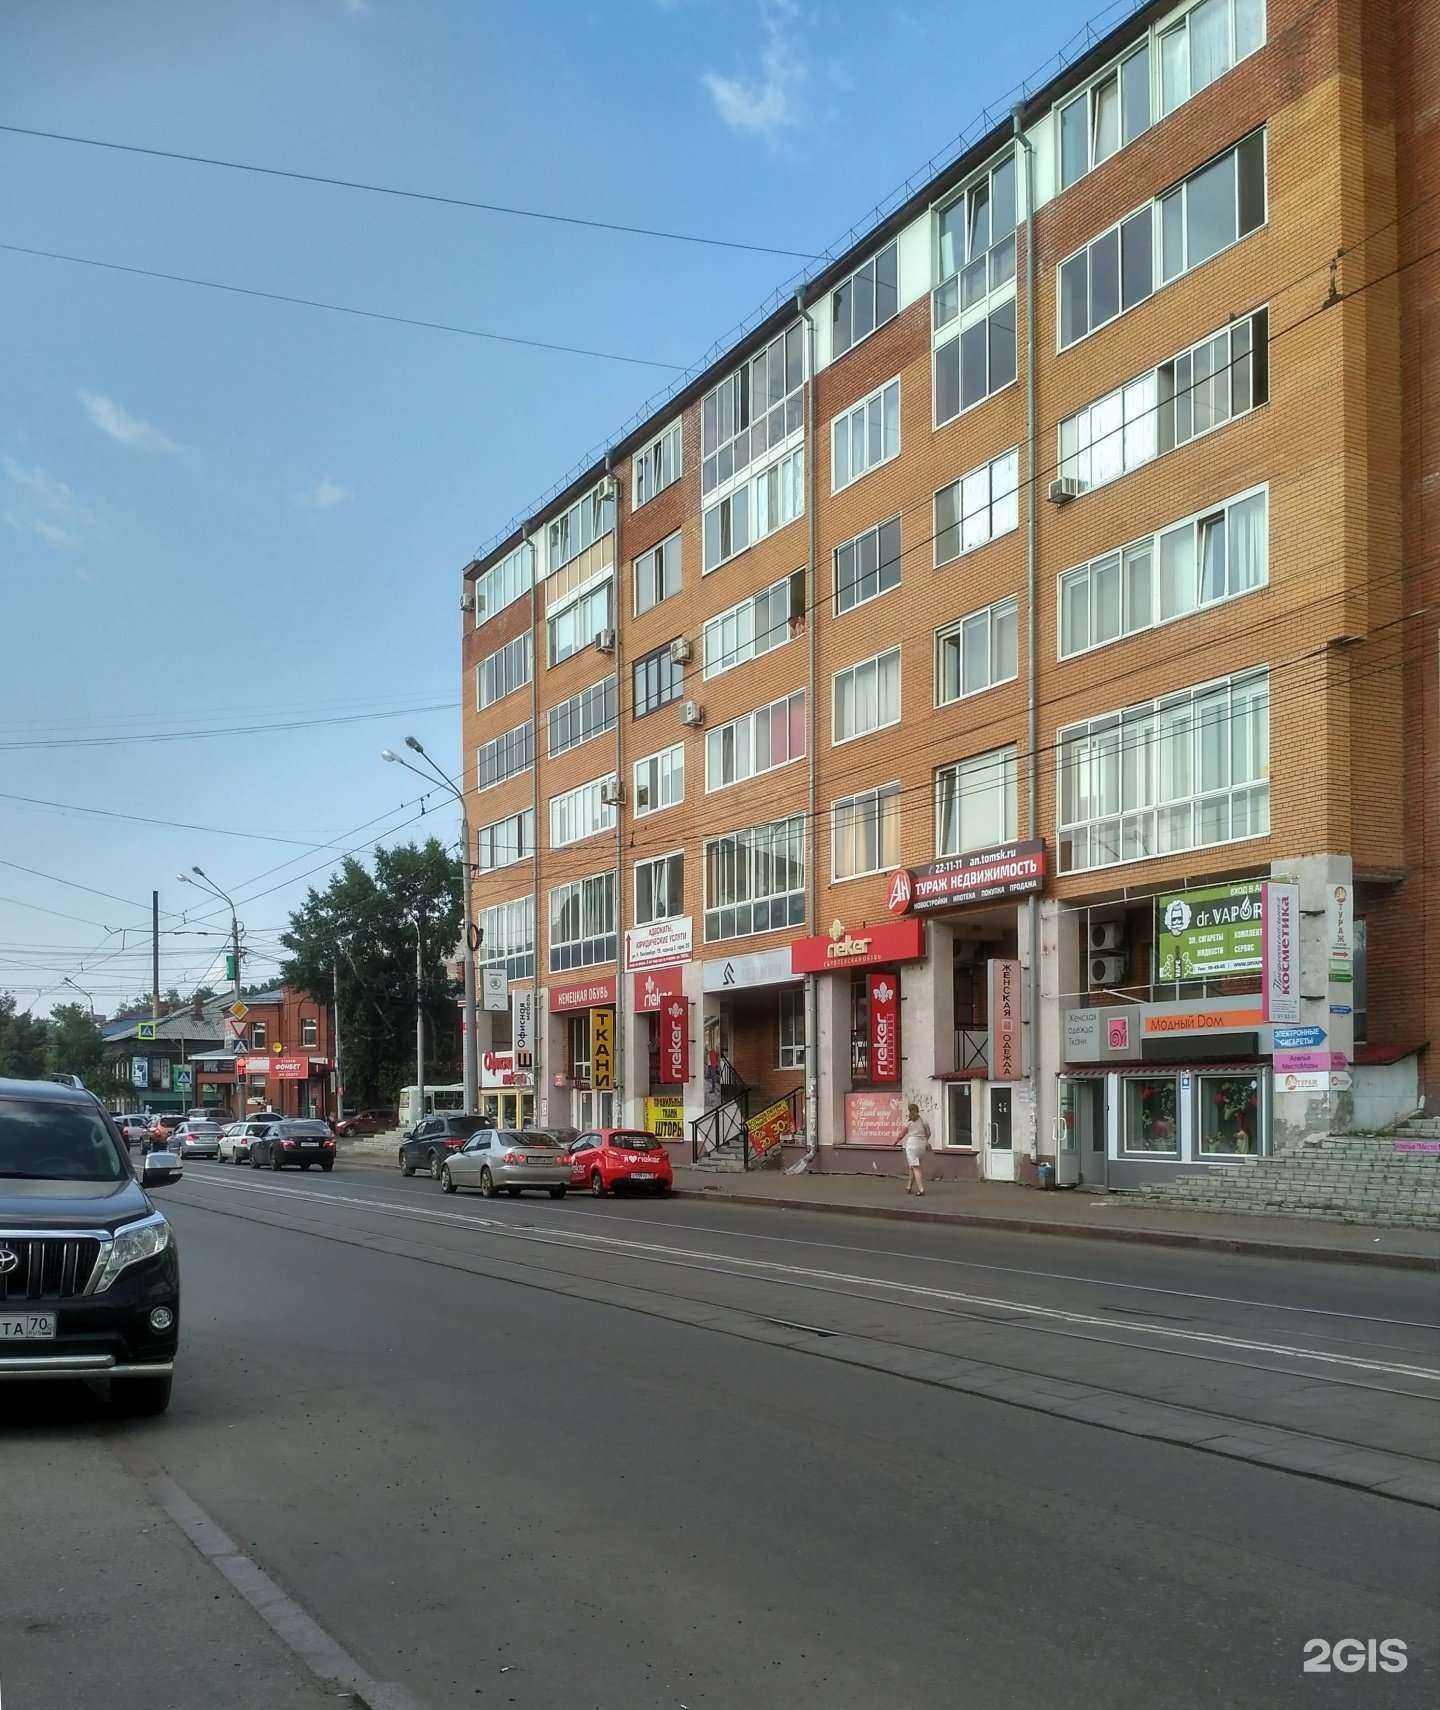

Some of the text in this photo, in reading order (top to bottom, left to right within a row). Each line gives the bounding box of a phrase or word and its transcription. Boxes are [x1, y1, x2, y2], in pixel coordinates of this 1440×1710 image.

[935, 849, 1017, 874] 22-11-11 an.tomsk.ru
[914, 859, 1037, 896] ТУРАЖ НЕДВИЖИМОСТЬ
[913, 879, 1037, 910] НОВОСТРОЙКИ ИПОТЕКА ПОКУПКА ПРОДАЖА
[1337, 903, 1345, 943] ТУРАЖ
[827, 935, 873, 958] rieker
[1198, 932, 1224, 944] СИГАРЕТЫ
[1233, 943, 1255, 953] СЕРВИС
[558, 986, 609, 1005] НЕМЕЦКАЯ ОБУВЬ
[644, 988, 673, 1007] riek
[1002, 963, 1012, 1017] ЖЕНСКАЯ
[517, 1003, 528, 1048] Офисная
[1069, 1013, 1097, 1022] Женская
[1151, 1014, 1195, 1032] Модный
[1067, 1025, 1094, 1034] одежда
[1274, 1028, 1320, 1038] ЭЛЕКТРОННЫЕ
[595, 1013, 610, 1087] ТКАНИ
[668, 1021, 682, 1078] rieker
[873, 1013, 888, 1076] rieker
[1280, 1037, 1314, 1046] СИГАРЕТЫ
[1002, 1034, 1012, 1075] ОДЕЖДА
[662, 1108, 678, 1118] ТКАНИ
[655, 1121, 684, 1138] ШТОРЫ
[30, 1317, 48, 1330] 70
